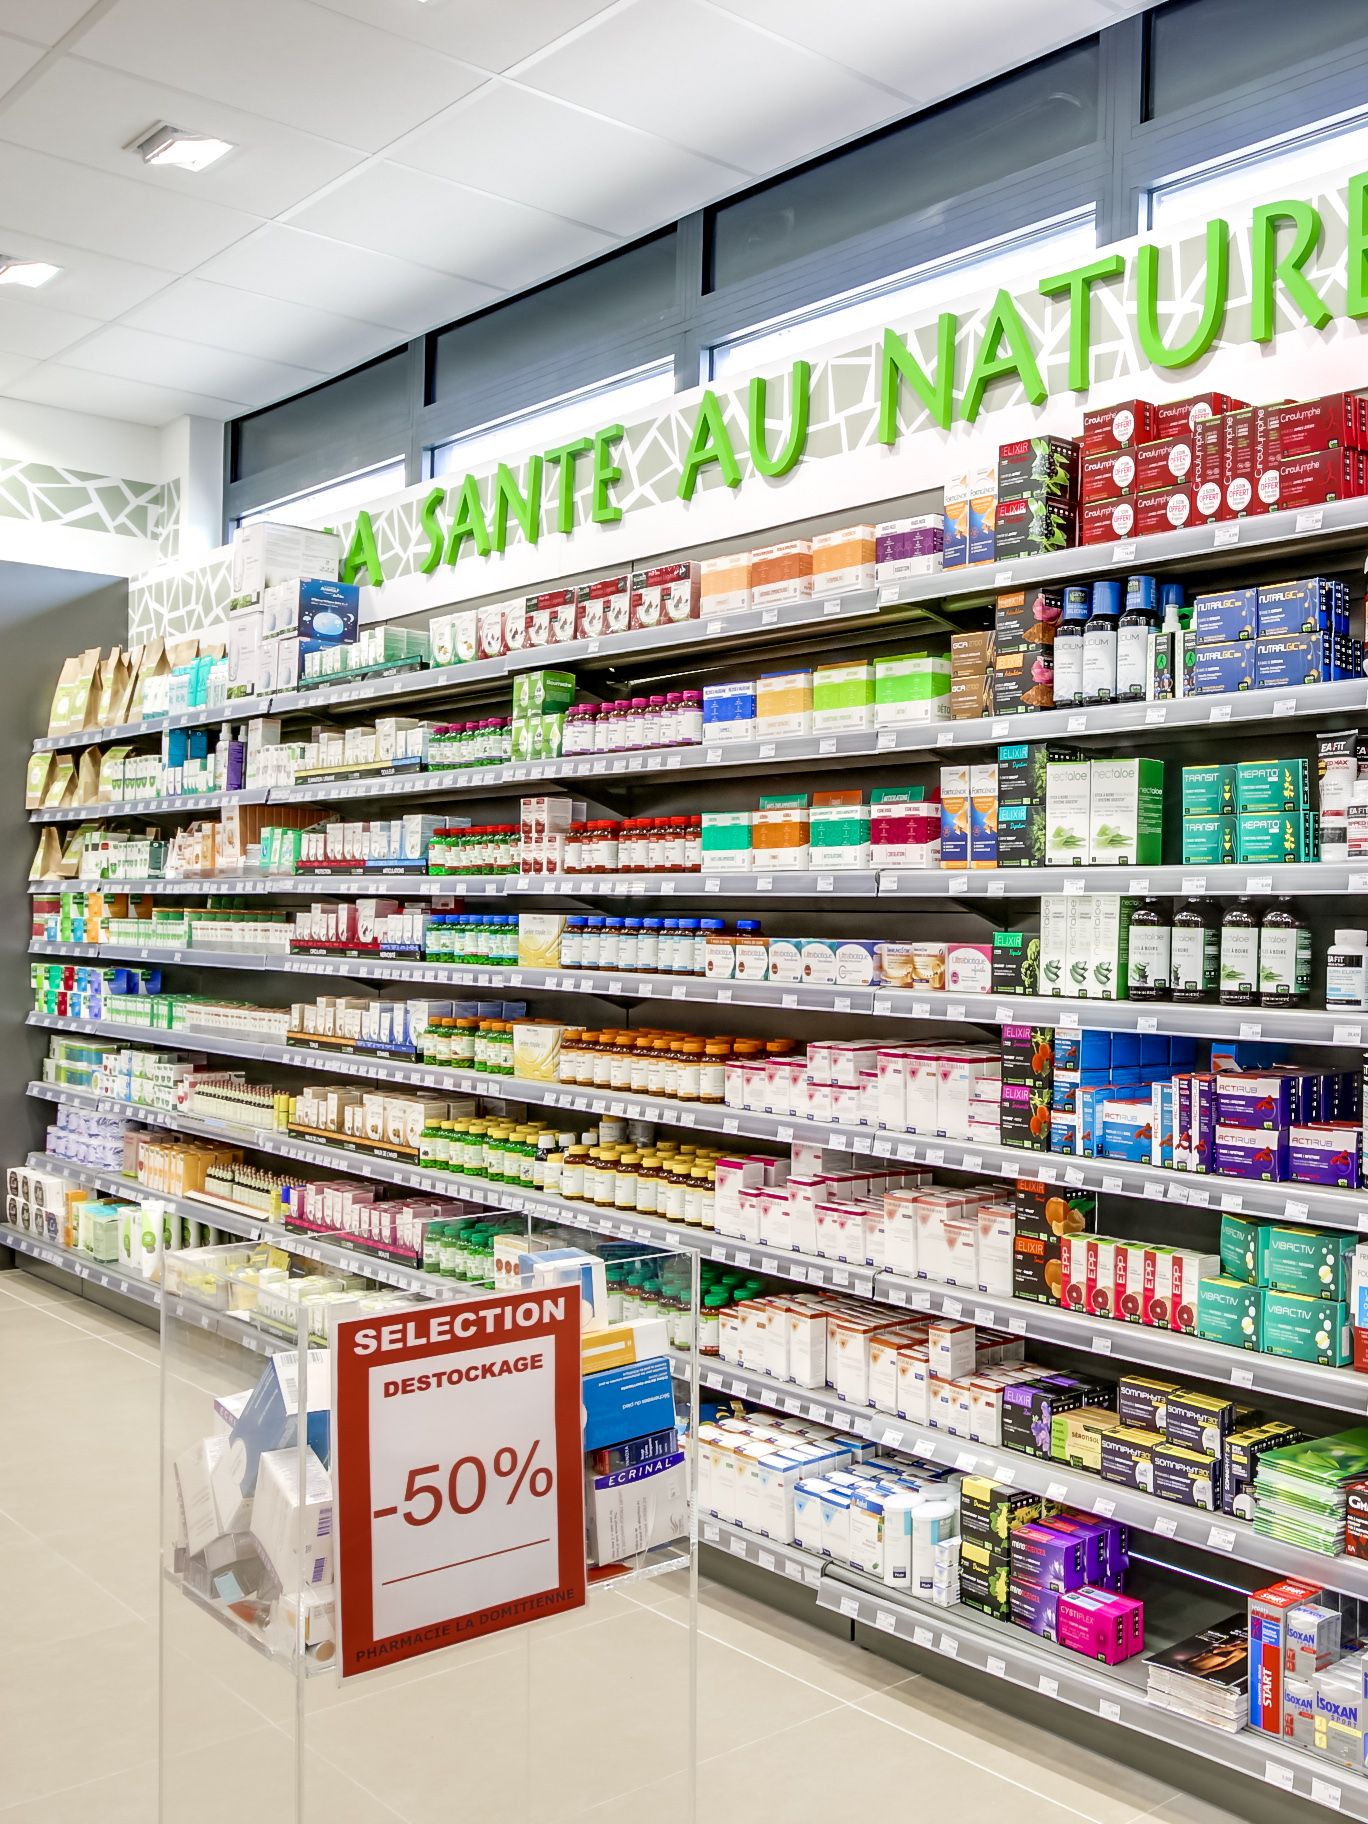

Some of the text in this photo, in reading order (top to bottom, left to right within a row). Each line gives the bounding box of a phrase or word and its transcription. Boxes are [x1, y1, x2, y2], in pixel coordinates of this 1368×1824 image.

[323, 510, 384, 588] A
[419, 422, 626, 575] SANTE
[677, 359, 811, 500] AU
[1271, 1241, 1315, 1254] VIBACTIV
[1117, 1255, 1125, 1283] EPP
[353, 1297, 565, 1355] SELECTION
[1267, 1305, 1311, 1320] VIBACTIV
[383, 1353, 544, 1398] DESTOCKAGE
[373, 1440, 552, 1527] -50%
[609, 1459, 673, 1487] ECRINAL
[355, 1588, 575, 1662] PHARMACIE LA DOMITIENNE
[1262, 1668, 1272, 1707] START
